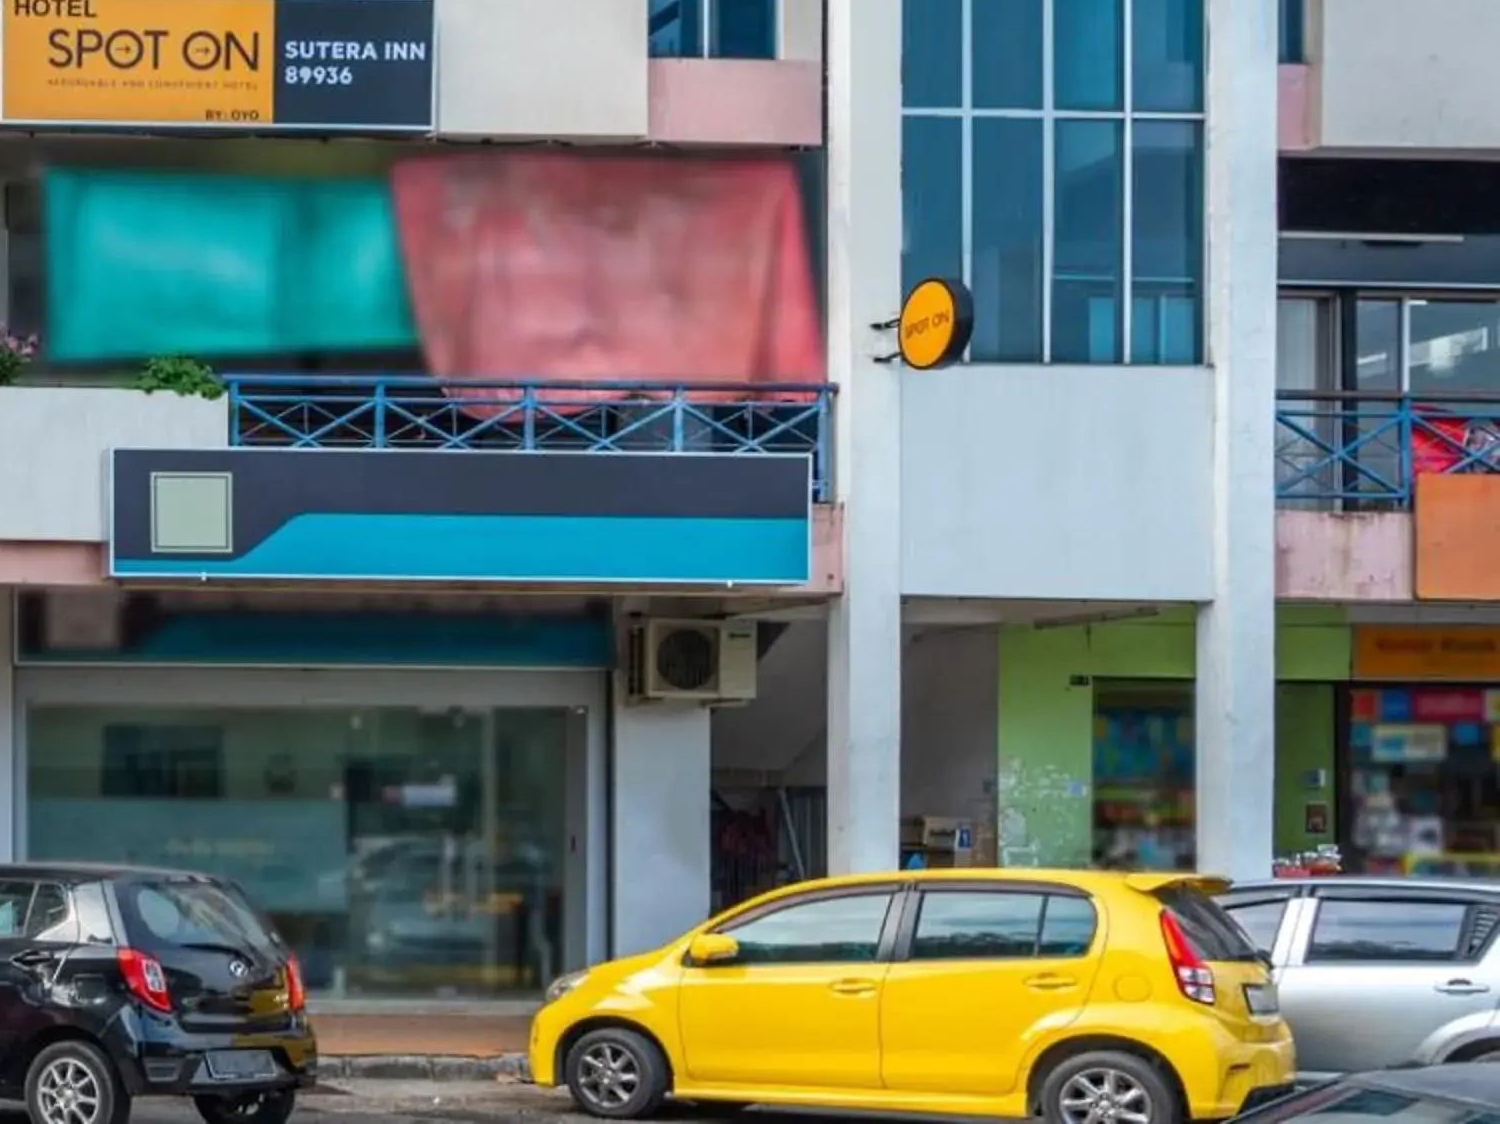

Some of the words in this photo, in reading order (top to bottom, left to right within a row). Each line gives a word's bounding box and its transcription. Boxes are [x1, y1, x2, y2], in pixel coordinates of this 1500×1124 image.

[48, 28, 169, 70] SPOT
[182, 30, 260, 71] ON
[285, 41, 378, 60] SUTERA
[384, 41, 426, 61] INN
[285, 65, 353, 85] 89936
